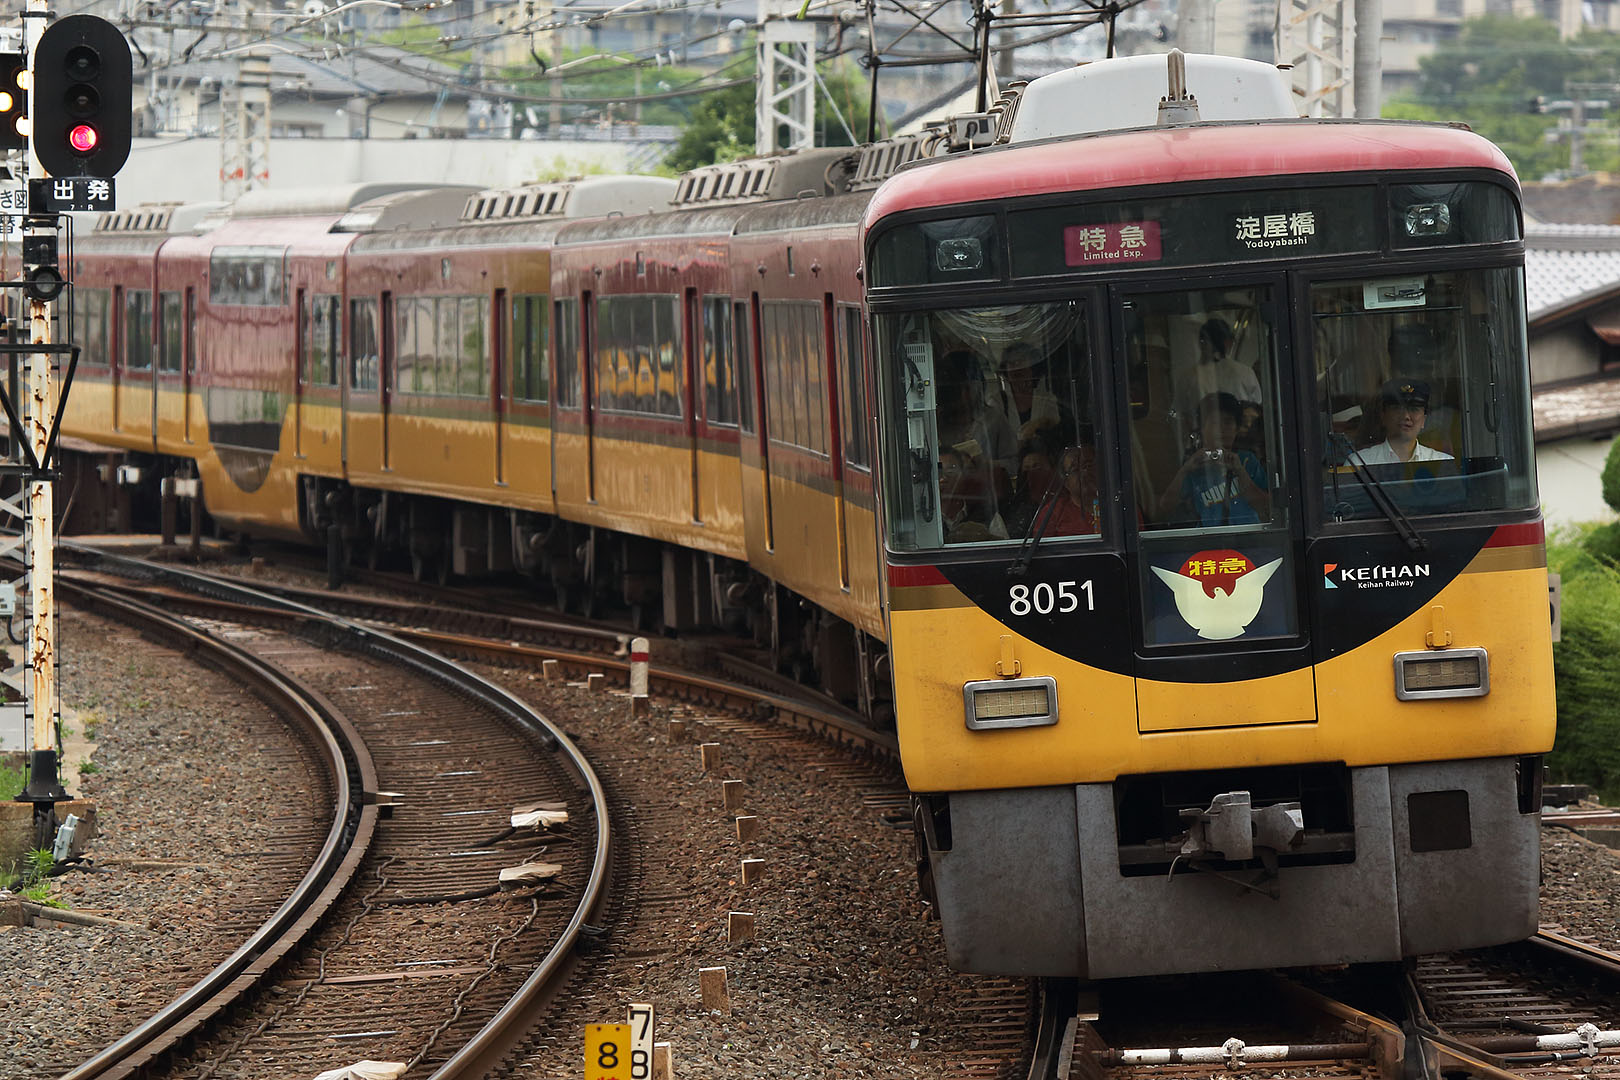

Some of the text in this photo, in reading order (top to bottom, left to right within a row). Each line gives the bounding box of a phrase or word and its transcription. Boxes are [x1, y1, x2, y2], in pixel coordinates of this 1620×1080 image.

[54, 179, 110, 201] 出発
[1235, 211, 1315, 240] 淀屋橋
[1079, 225, 1147, 251] 特急
[1245, 235, 1308, 249] Yodoyabashi
[1083, 248, 1144, 261] Limited Exp.
[1188, 557, 1247, 576] 特急
[1341, 564, 1430, 581] KEIHAN
[1357, 579, 1415, 590] Keihan Railway
[1008, 579, 1095, 616] 8051
[597, 1041, 619, 1069] 8
